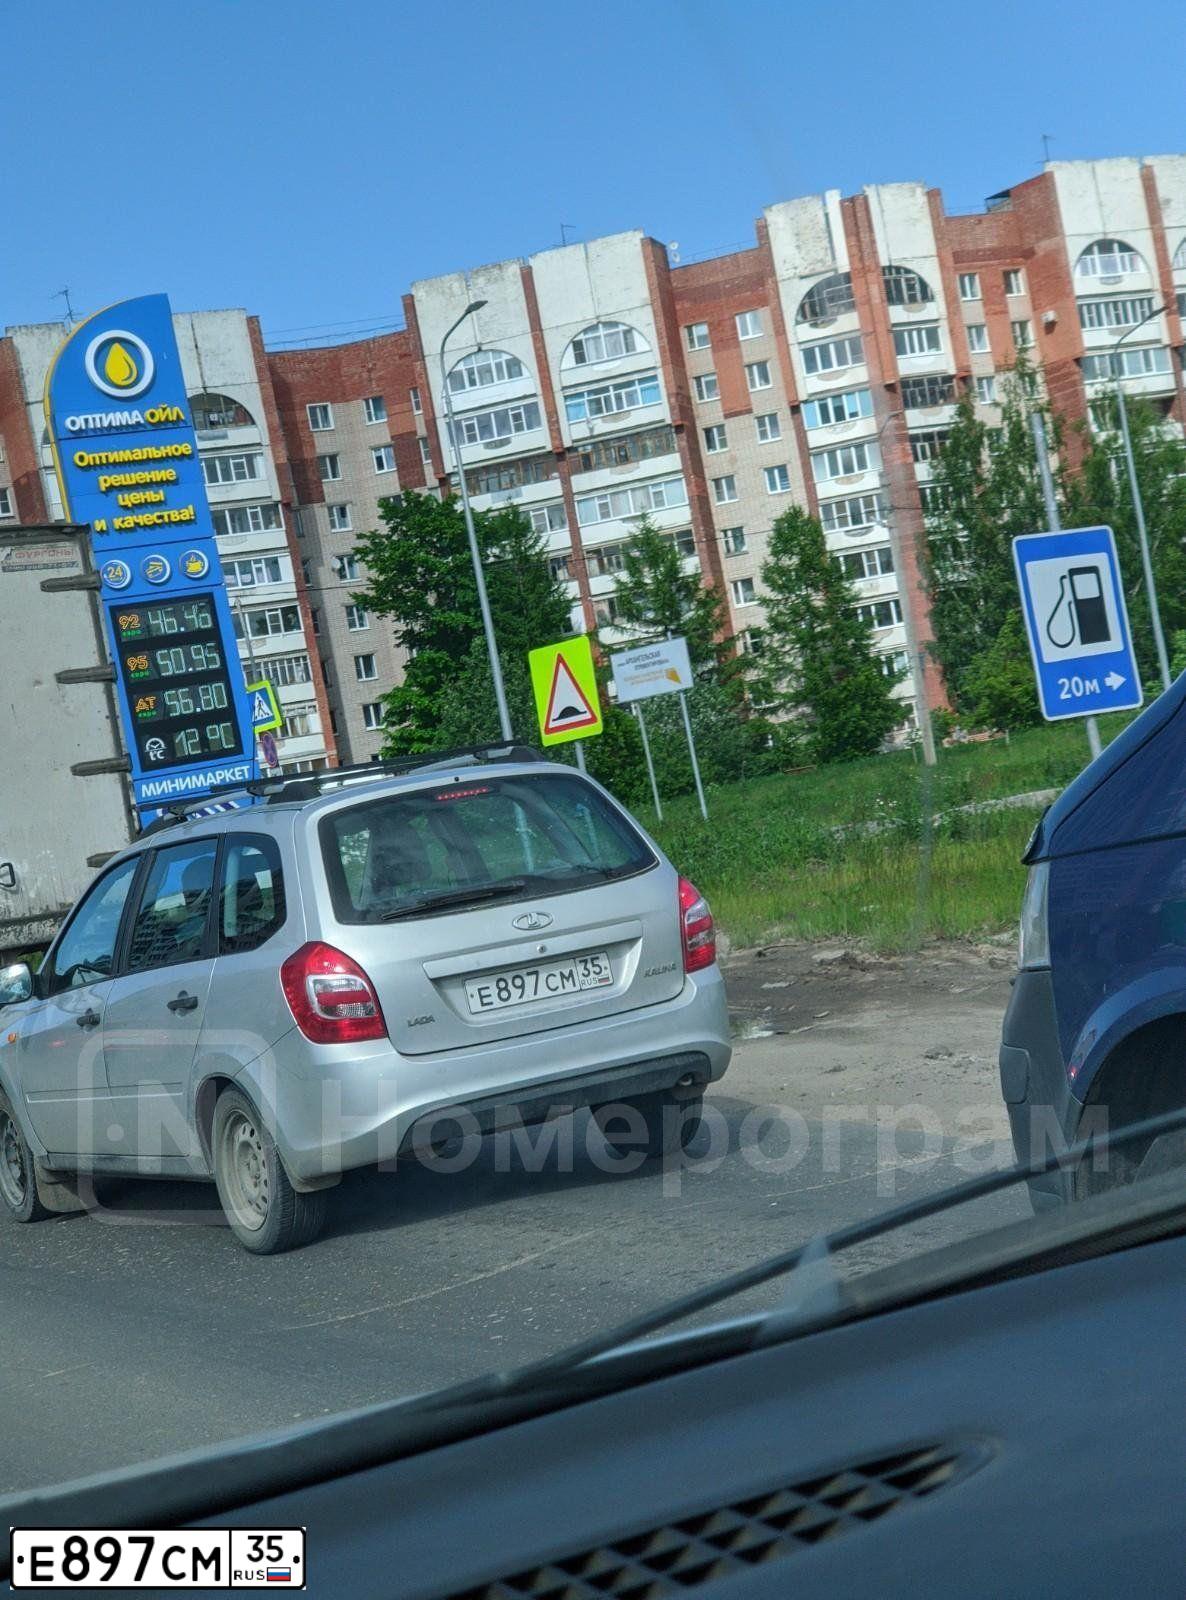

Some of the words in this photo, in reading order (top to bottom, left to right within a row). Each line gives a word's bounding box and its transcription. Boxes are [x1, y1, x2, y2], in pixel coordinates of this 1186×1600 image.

[65, 409, 144, 431] ОПТИМА
[144, 404, 185, 424] ОЙЛ
[74, 442, 192, 467] Оптимальное
[99, 469, 176, 491] решение
[117, 489, 164, 508] цены
[94, 518, 107, 532] и
[114, 505, 195, 530] качества!
[107, 565, 123, 578] 24
[119, 614, 141, 630] 92
[148, 602, 213, 634] 46.46
[127, 655, 149, 671] 95
[156, 642, 221, 676] 50.95
[163, 682, 228, 717] 56.80
[141, 765, 251, 797] МИНИМАРКЕТ
[579, 956, 603, 978] 35
[644, 963, 677, 978] KALINA
[581, 976, 600, 987] RUS
[407, 1014, 435, 1027] LADA
